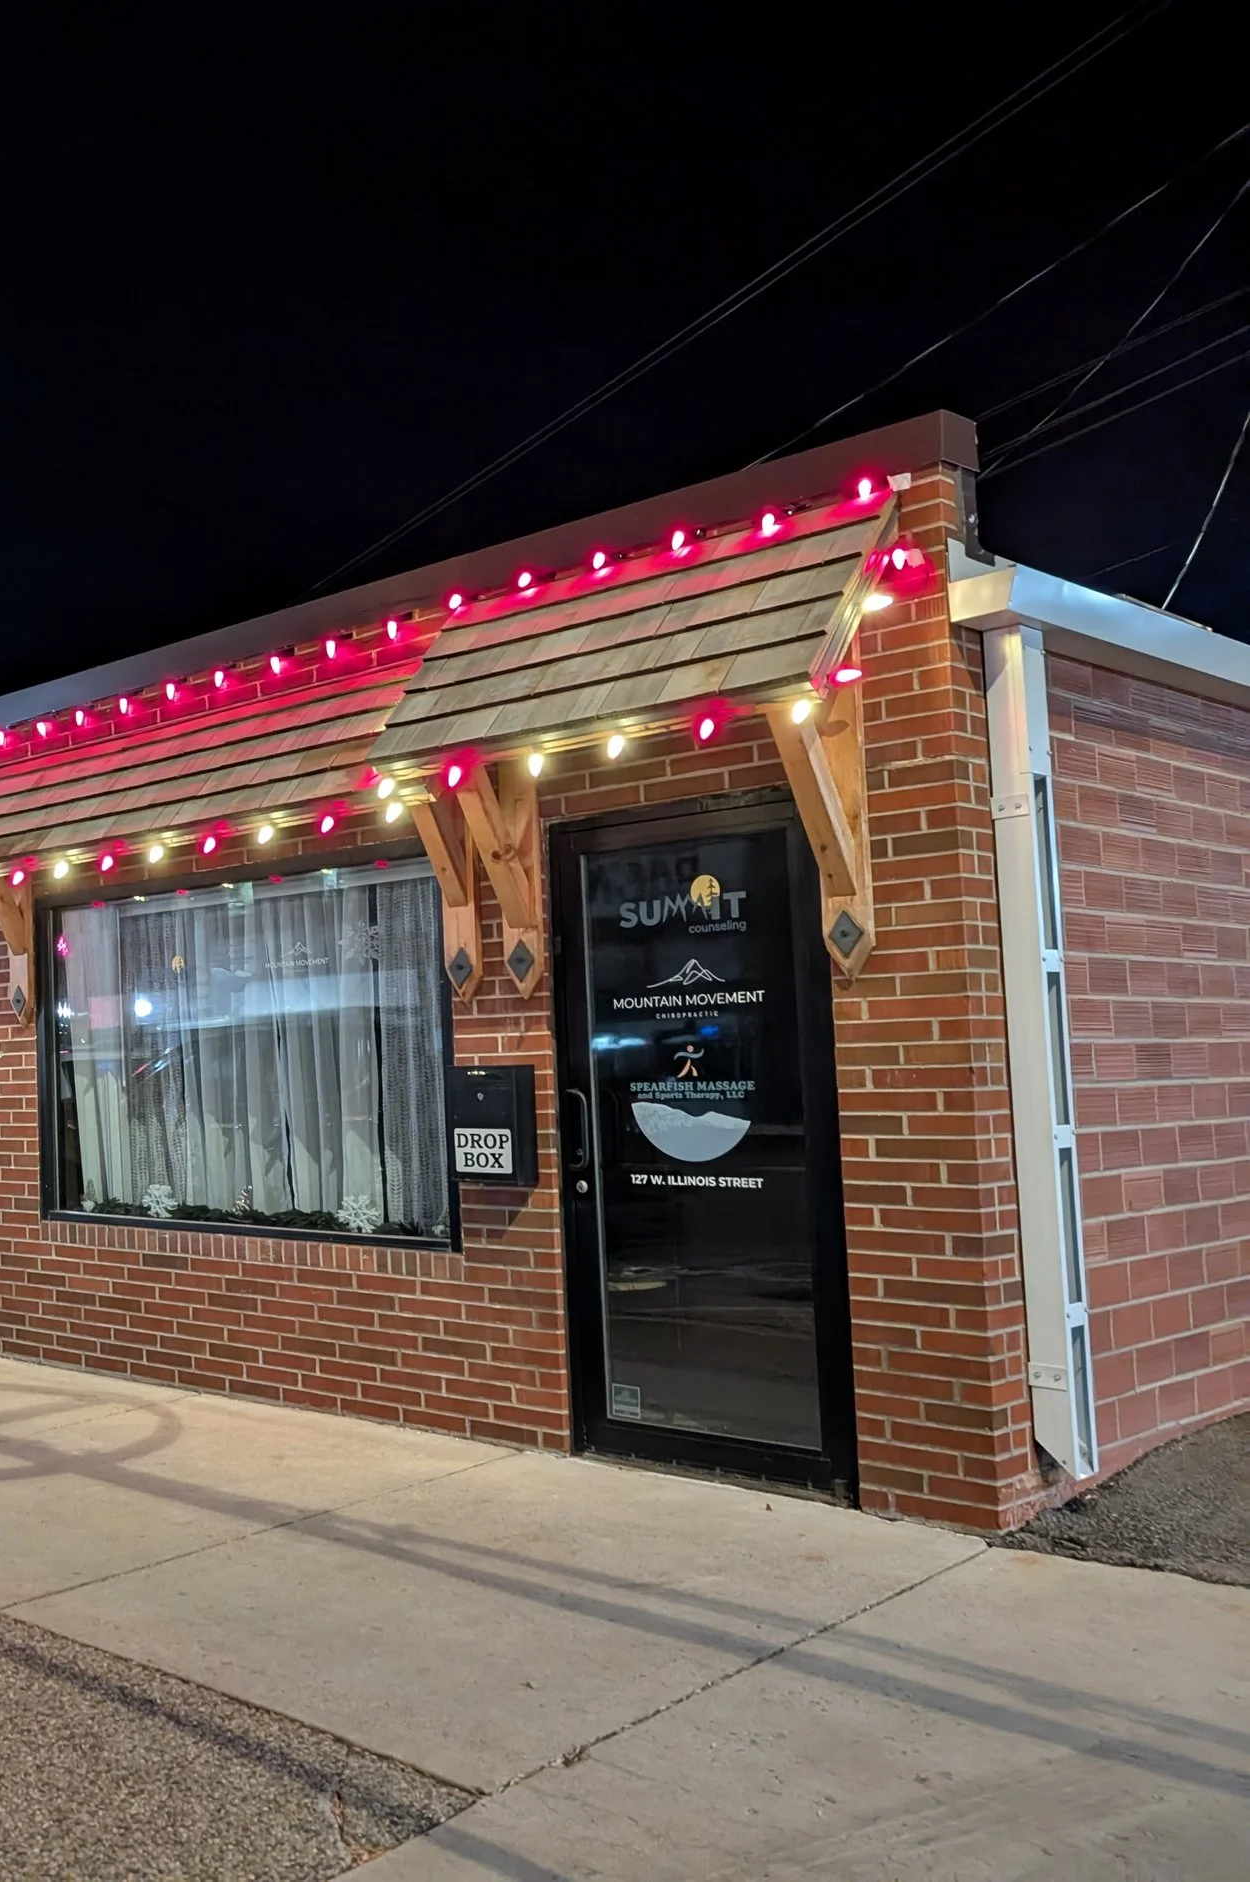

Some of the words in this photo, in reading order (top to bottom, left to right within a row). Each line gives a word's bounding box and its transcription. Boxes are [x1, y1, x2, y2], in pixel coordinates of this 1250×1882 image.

[619, 890, 747, 929] SUMMIT
[688, 919, 747, 934] counseling
[264, 960, 295, 969] MOUNTAIN
[295, 957, 329, 967] MOVEMENT
[613, 994, 682, 1010] MOUNTAIN
[685, 989, 766, 1006] MOVEMENT
[655, 1010, 719, 1020] CHIROPRACTIC
[629, 1081, 694, 1092] SPEARFISH
[696, 1080, 756, 1091] MASSAGE
[655, 1091, 683, 1100] Sports
[685, 1091, 725, 1100] Therapy,
[456, 1133, 510, 1149] DROP
[463, 1152, 505, 1169] BOX
[630, 1174, 648, 1185] 127
[649, 1174, 666, 1186] W.
[667, 1175, 716, 1187] ILLINOIS
[718, 1177, 764, 1189] STREET
